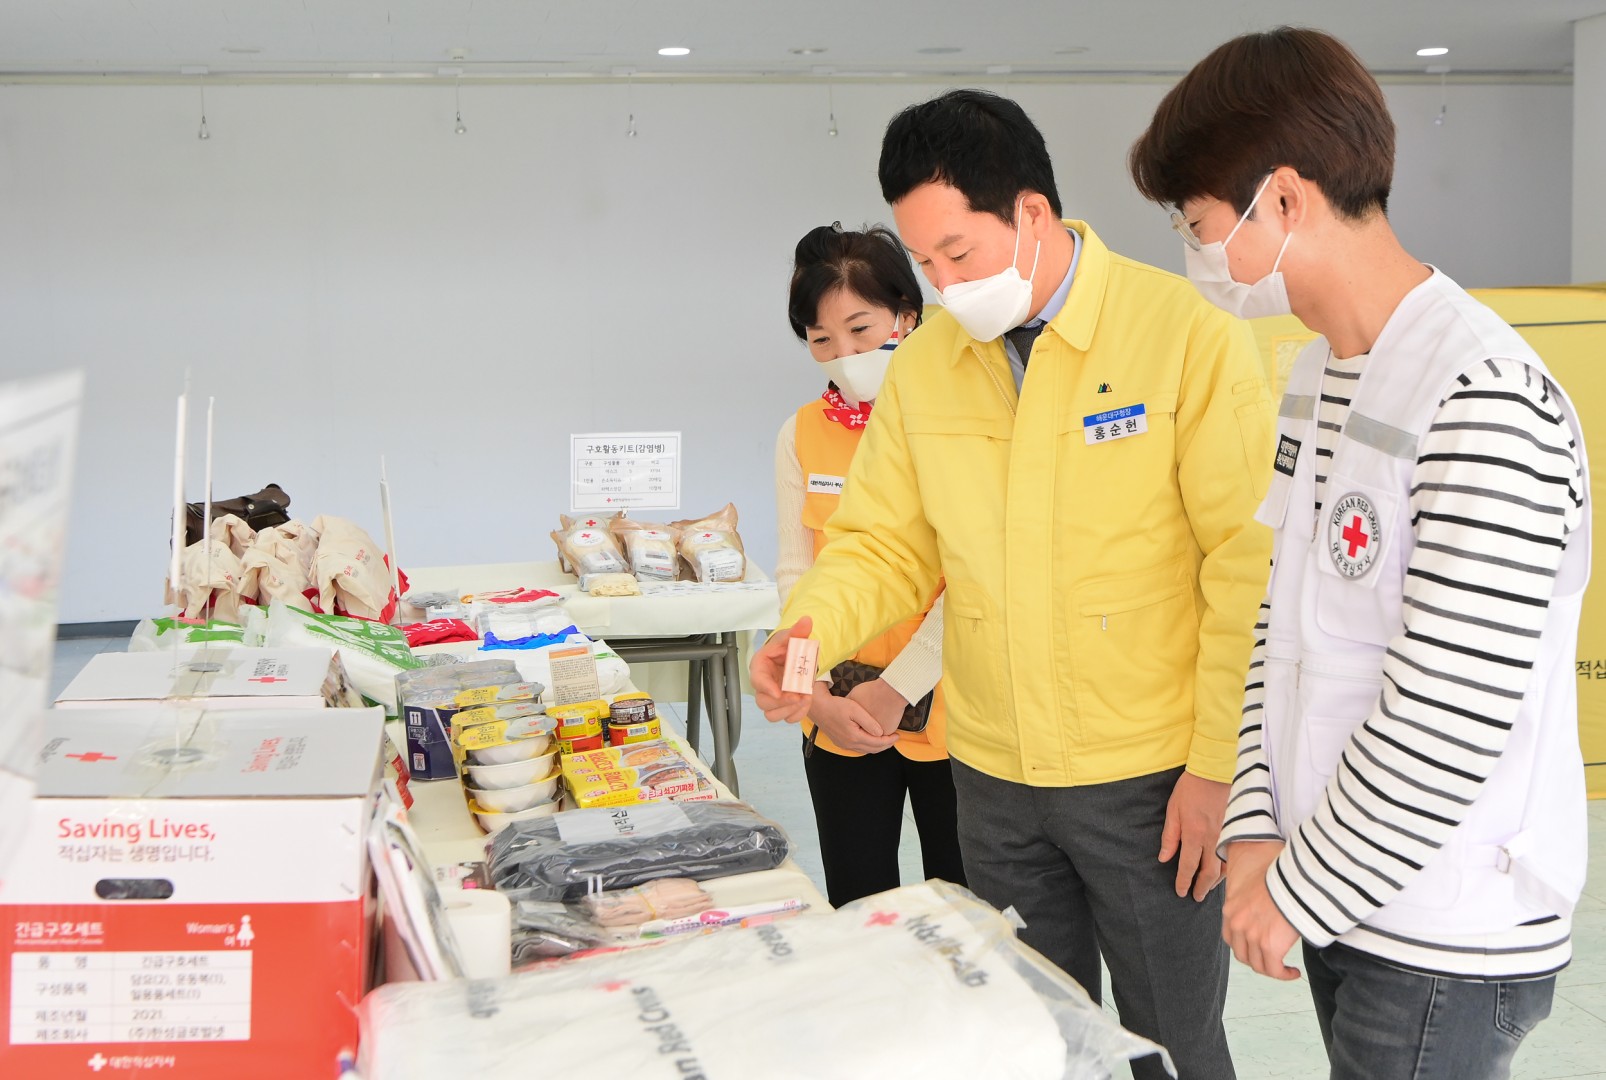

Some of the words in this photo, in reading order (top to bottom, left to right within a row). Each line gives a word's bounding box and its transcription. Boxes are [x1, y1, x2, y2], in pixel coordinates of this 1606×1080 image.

[1333, 497, 1355, 527] KOREAN
[1356, 497, 1369, 513] RED
[1368, 511, 1379, 542] CROSS
[58, 818, 141, 843] Saving
[149, 818, 217, 841] Lives,
[58, 844, 124, 863] 적십자는
[129, 844, 215, 863] 생명입니다.
[15, 921, 104, 938] 긴급구호세트
